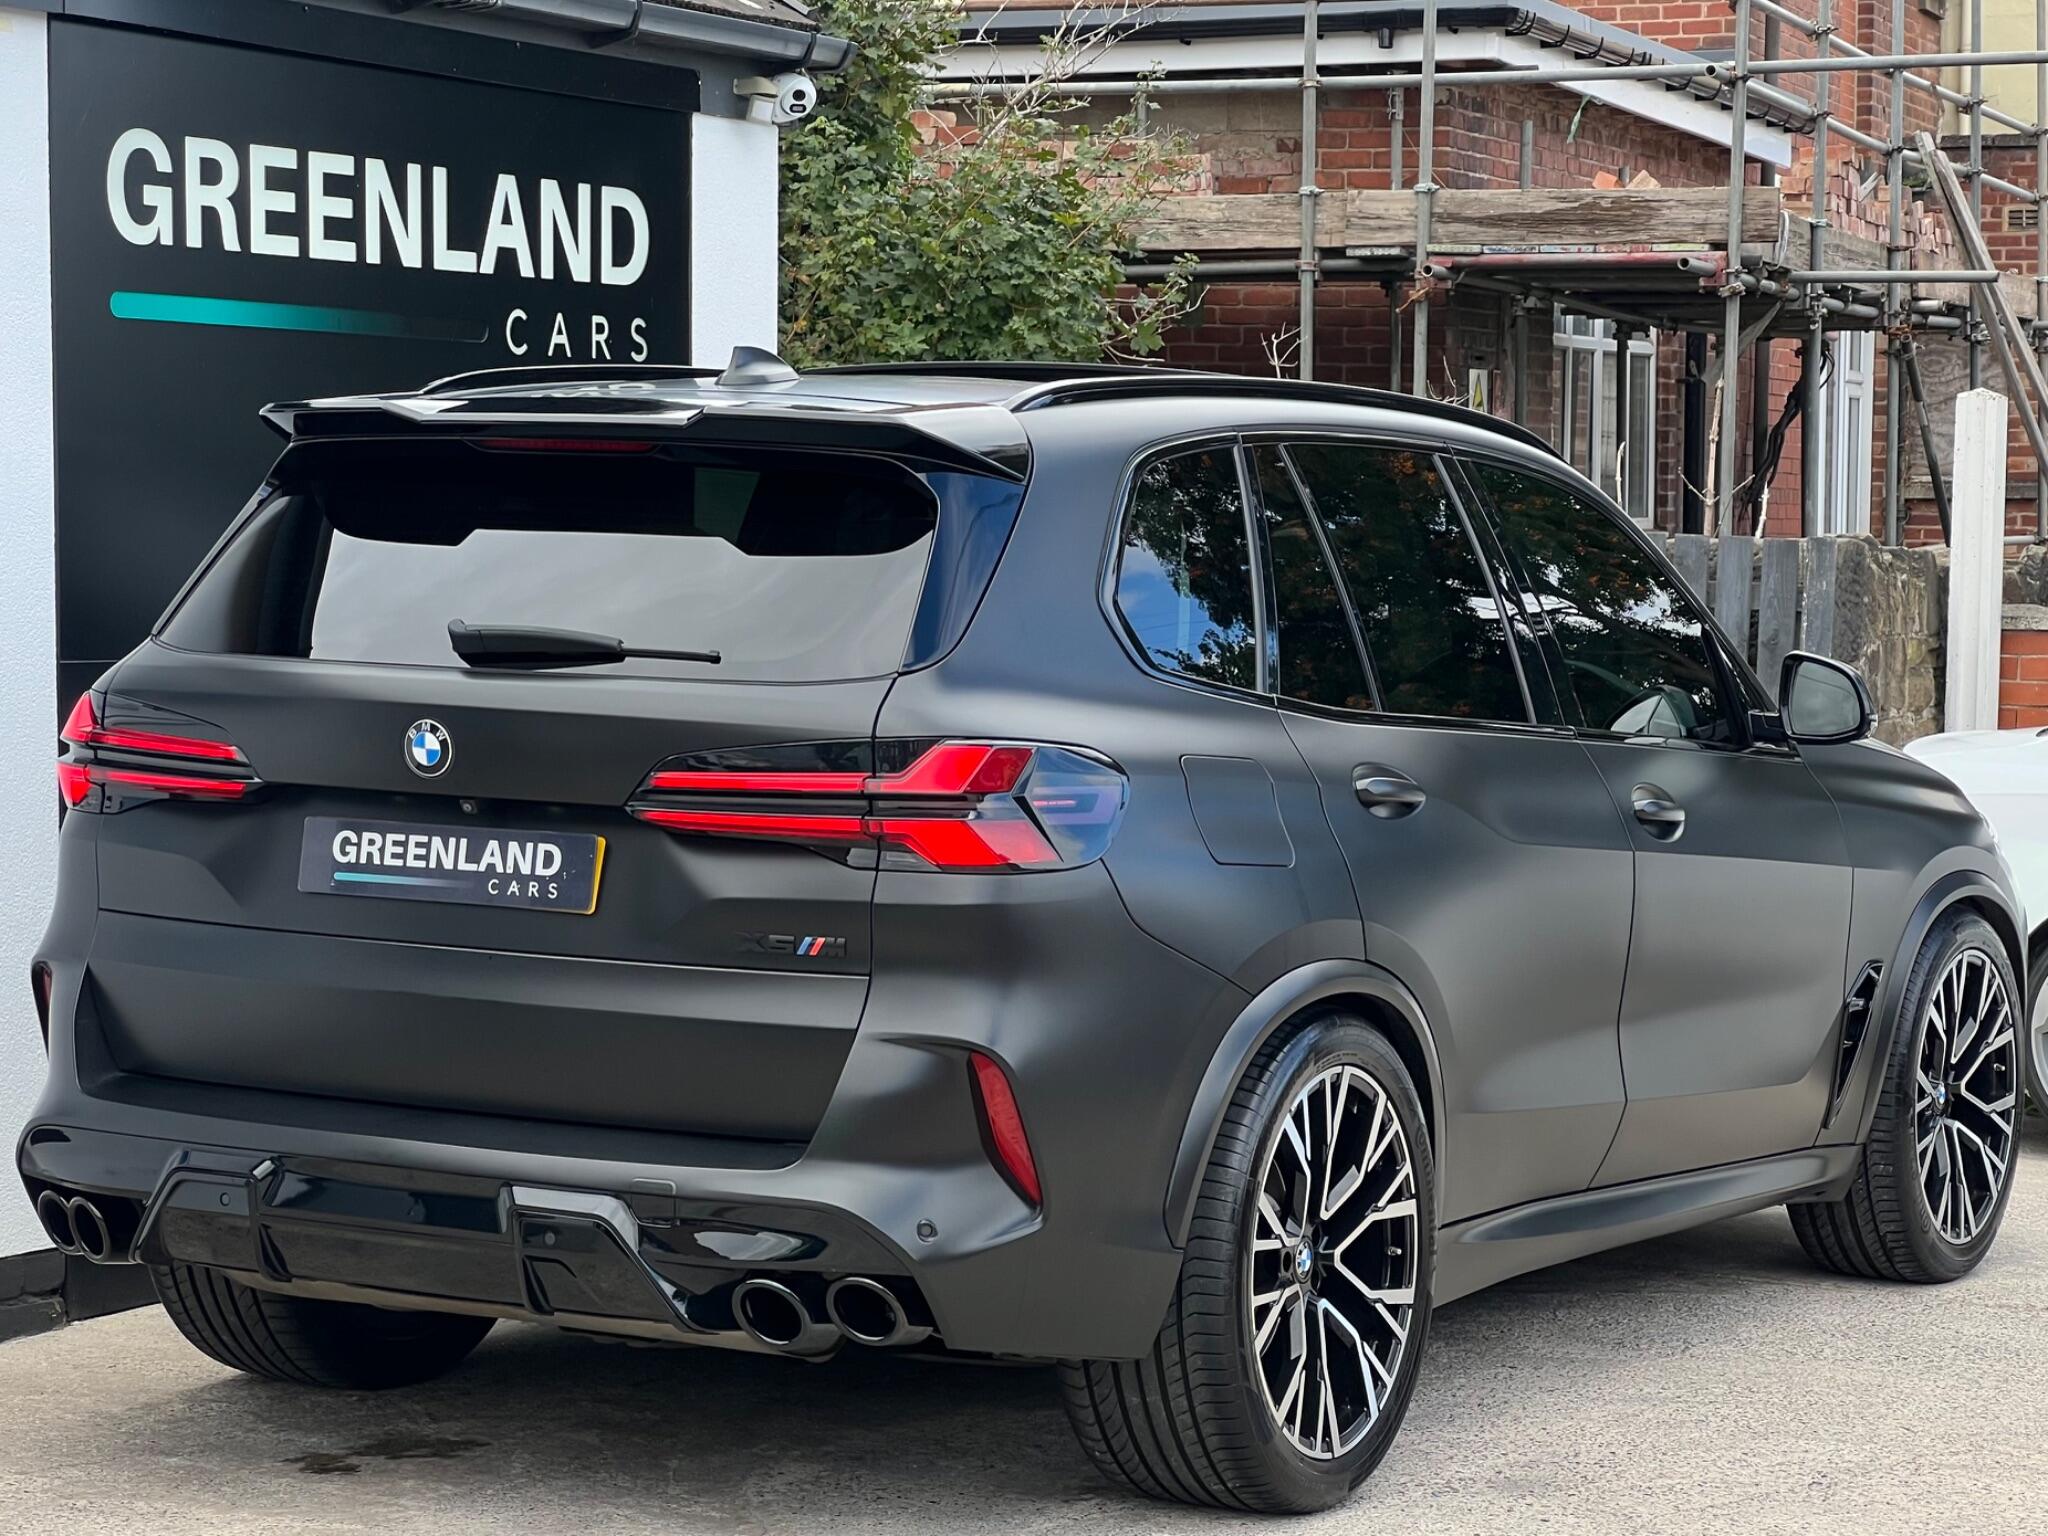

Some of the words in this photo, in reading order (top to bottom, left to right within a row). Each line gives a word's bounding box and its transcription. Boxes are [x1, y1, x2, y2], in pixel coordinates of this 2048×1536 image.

[106, 127, 650, 286] GREENLAND
[505, 308, 649, 363] CARS
[332, 830, 563, 877] GREENLAND
[487, 878, 559, 899] CARS
